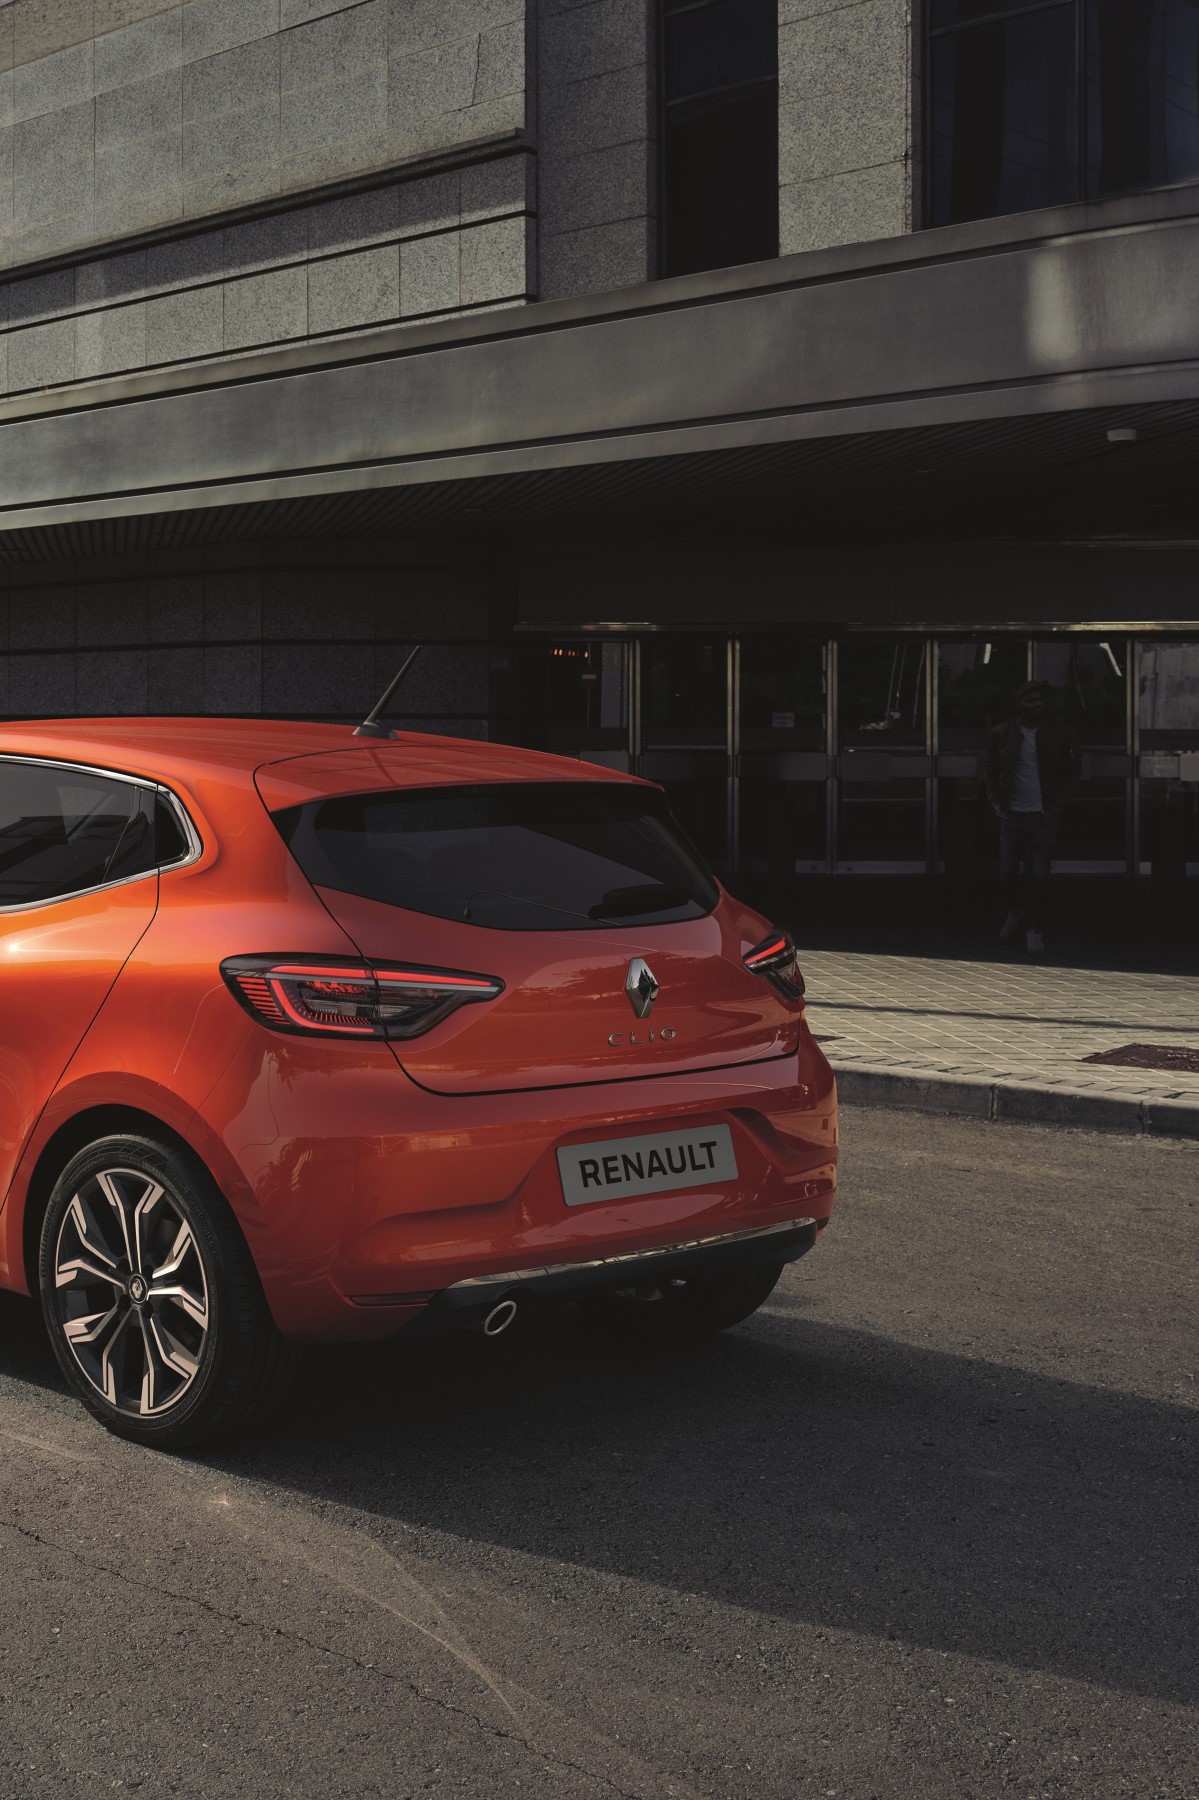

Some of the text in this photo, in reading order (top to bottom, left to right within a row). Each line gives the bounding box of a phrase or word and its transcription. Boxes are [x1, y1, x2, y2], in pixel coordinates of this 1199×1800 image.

[608, 1026, 677, 1046] CLIO
[579, 1141, 717, 1188] RENAULT
[39, 1199, 57, 1279] Continental
